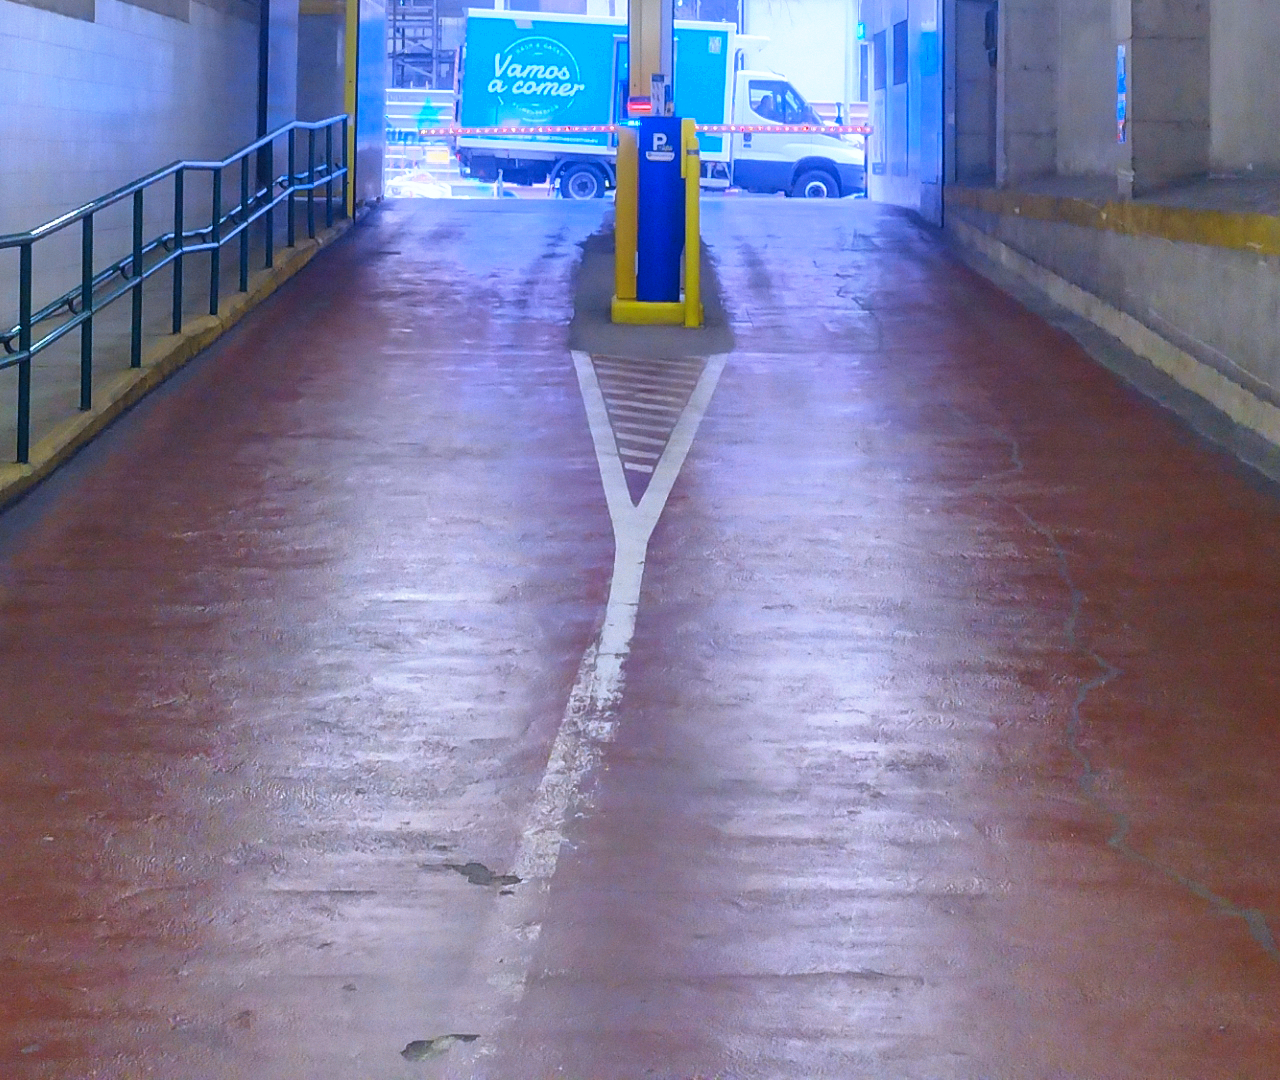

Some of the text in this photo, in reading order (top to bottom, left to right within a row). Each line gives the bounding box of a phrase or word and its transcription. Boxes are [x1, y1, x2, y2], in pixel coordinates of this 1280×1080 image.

[494, 53, 570, 80] Vamos
[488, 79, 585, 97] a comer
